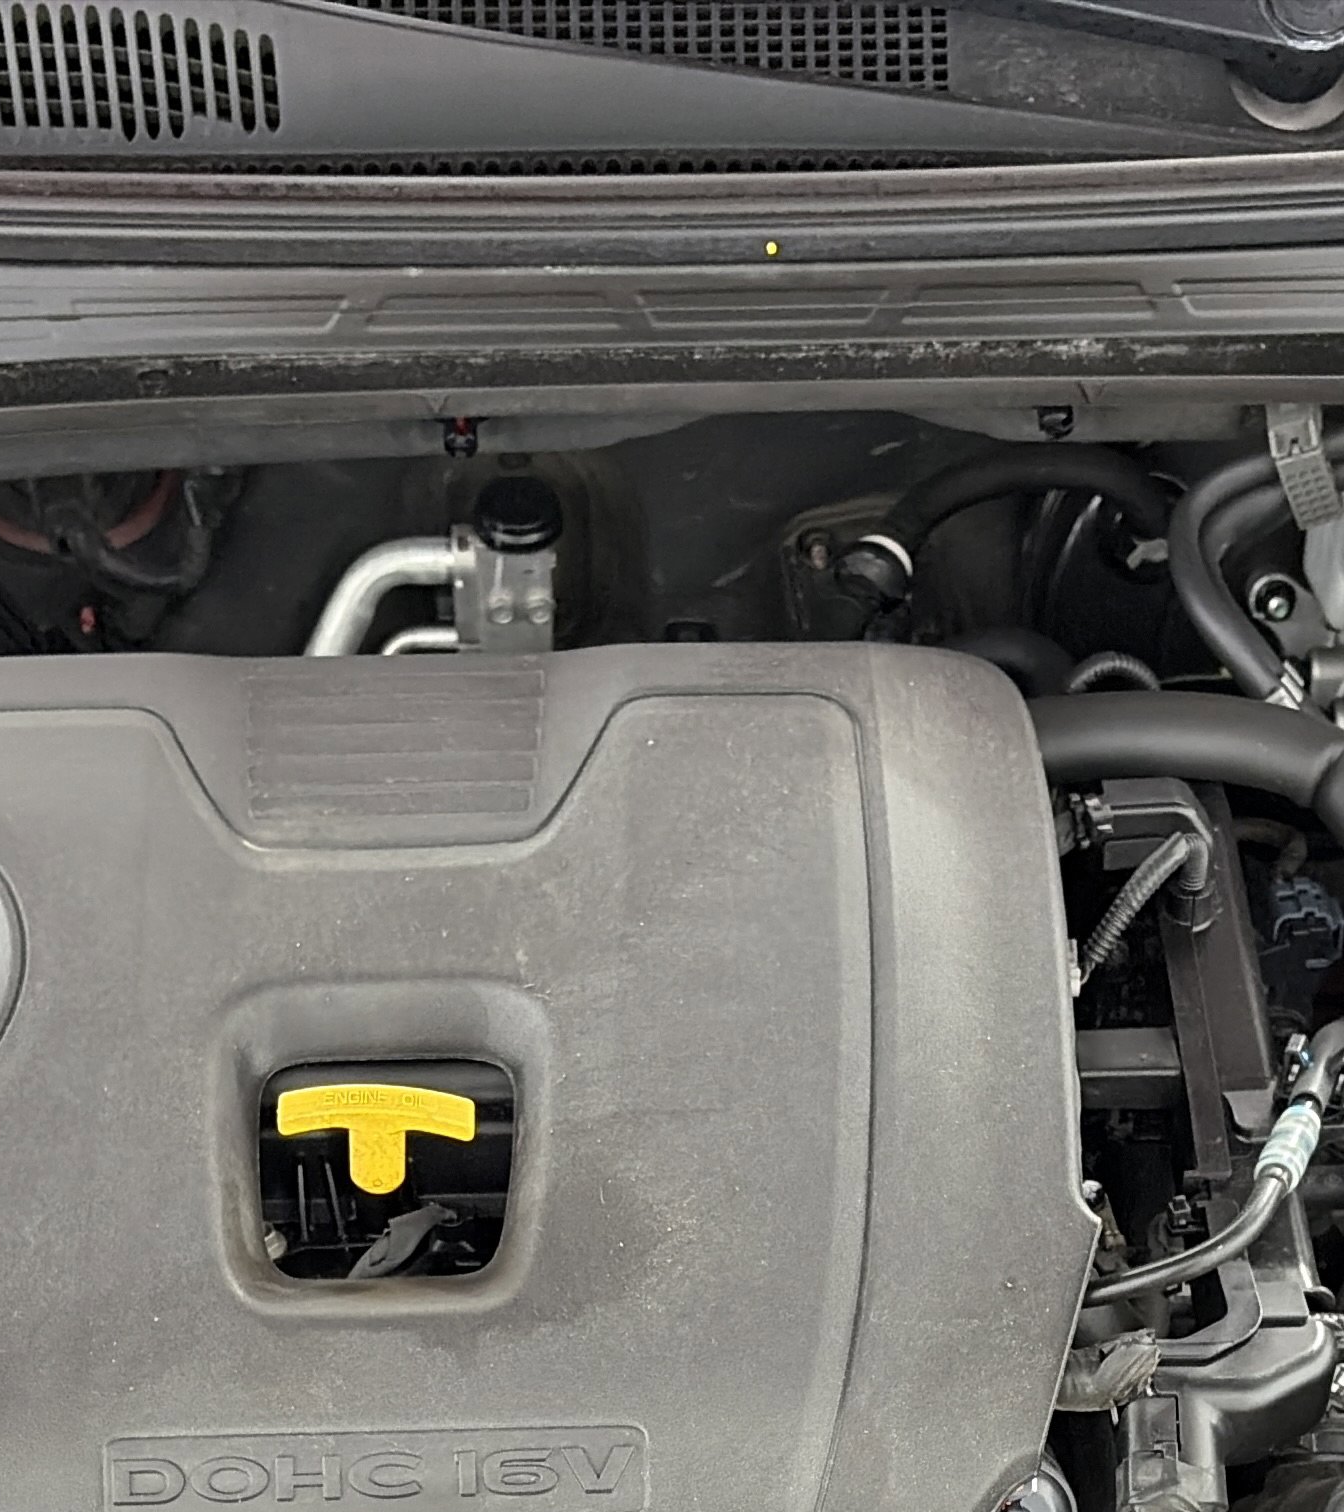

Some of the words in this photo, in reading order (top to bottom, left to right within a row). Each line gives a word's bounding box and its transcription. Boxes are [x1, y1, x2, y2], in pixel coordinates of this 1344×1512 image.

[322, 1090, 388, 1106] ENGINE
[401, 1091, 429, 1108] OIL
[112, 1451, 424, 1506] DOHC
[456, 1445, 635, 1499] 16V
